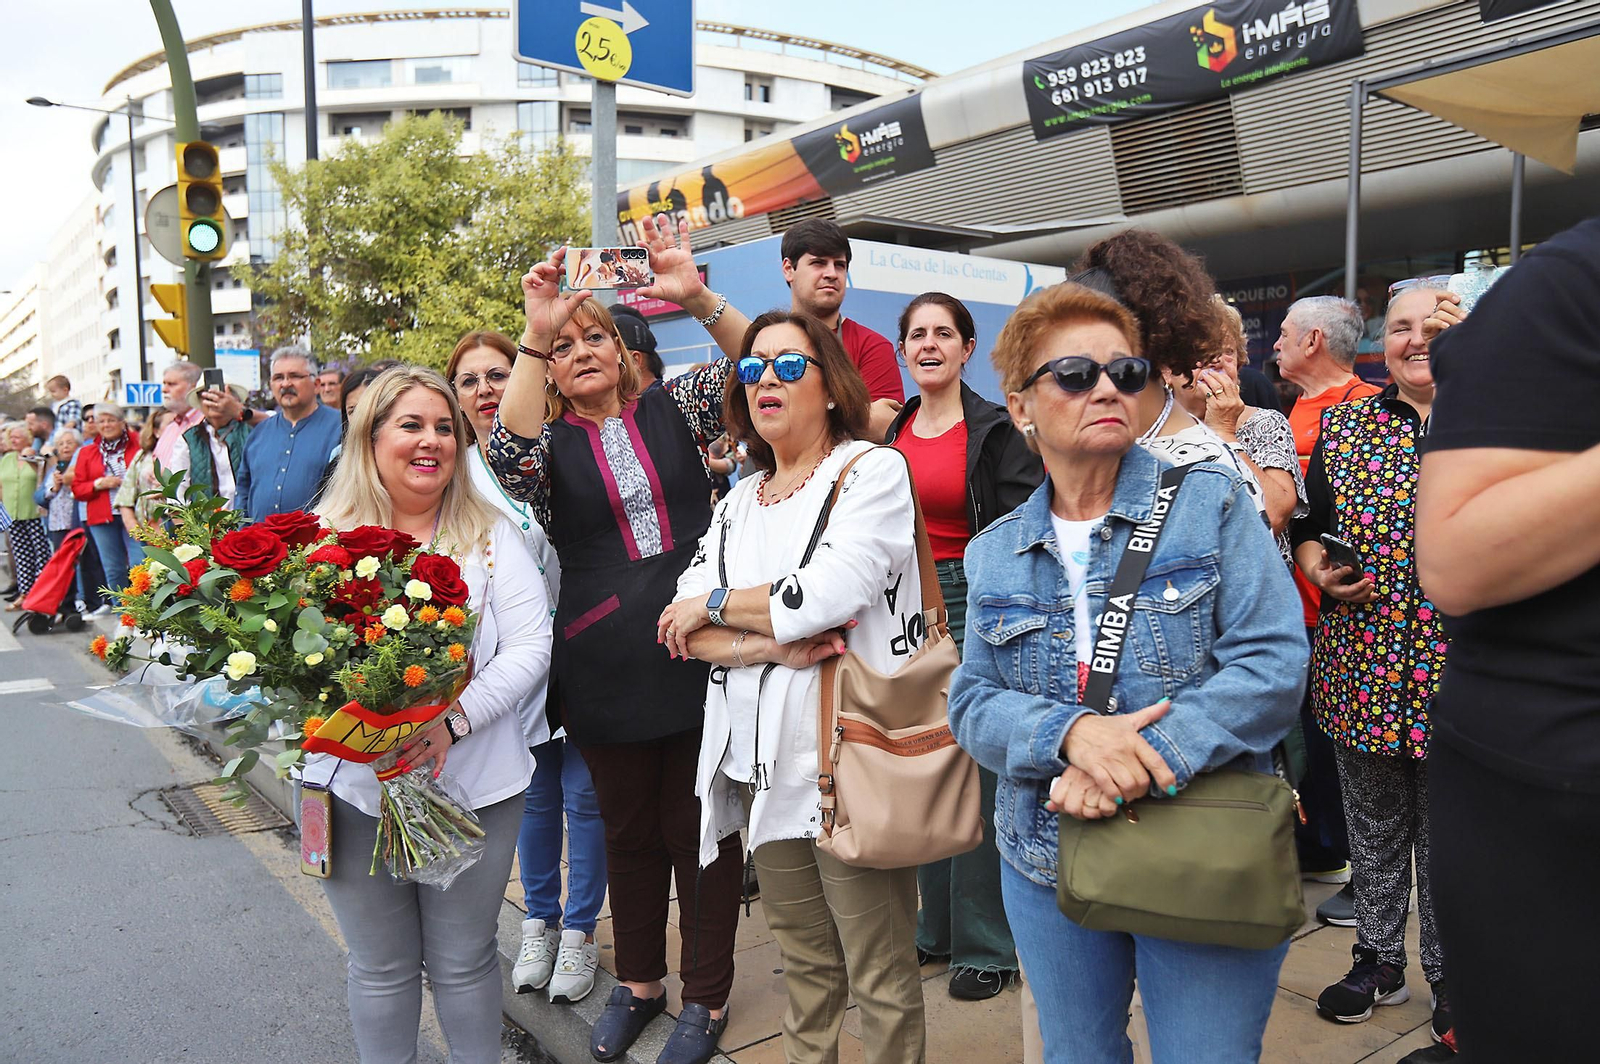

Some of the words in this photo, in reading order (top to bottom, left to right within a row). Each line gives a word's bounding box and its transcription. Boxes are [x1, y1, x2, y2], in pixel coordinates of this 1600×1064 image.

[1047, 66, 1077, 87] 959
[1081, 57, 1111, 78] 823
[1114, 46, 1146, 69] 823
[1051, 86, 1079, 106] 681
[1083, 77, 1114, 98] 913
[1117, 66, 1148, 88] 617
[1221, 79, 1231, 88] La
[1264, 57, 1309, 77] inteligente
[870, 250, 887, 267] La
[890, 253, 921, 272] Casa
[925, 257, 939, 273] de
[942, 259, 959, 276] las
[962, 262, 1008, 283] Cuentas
[1091, 593, 1134, 674] BIMBA
